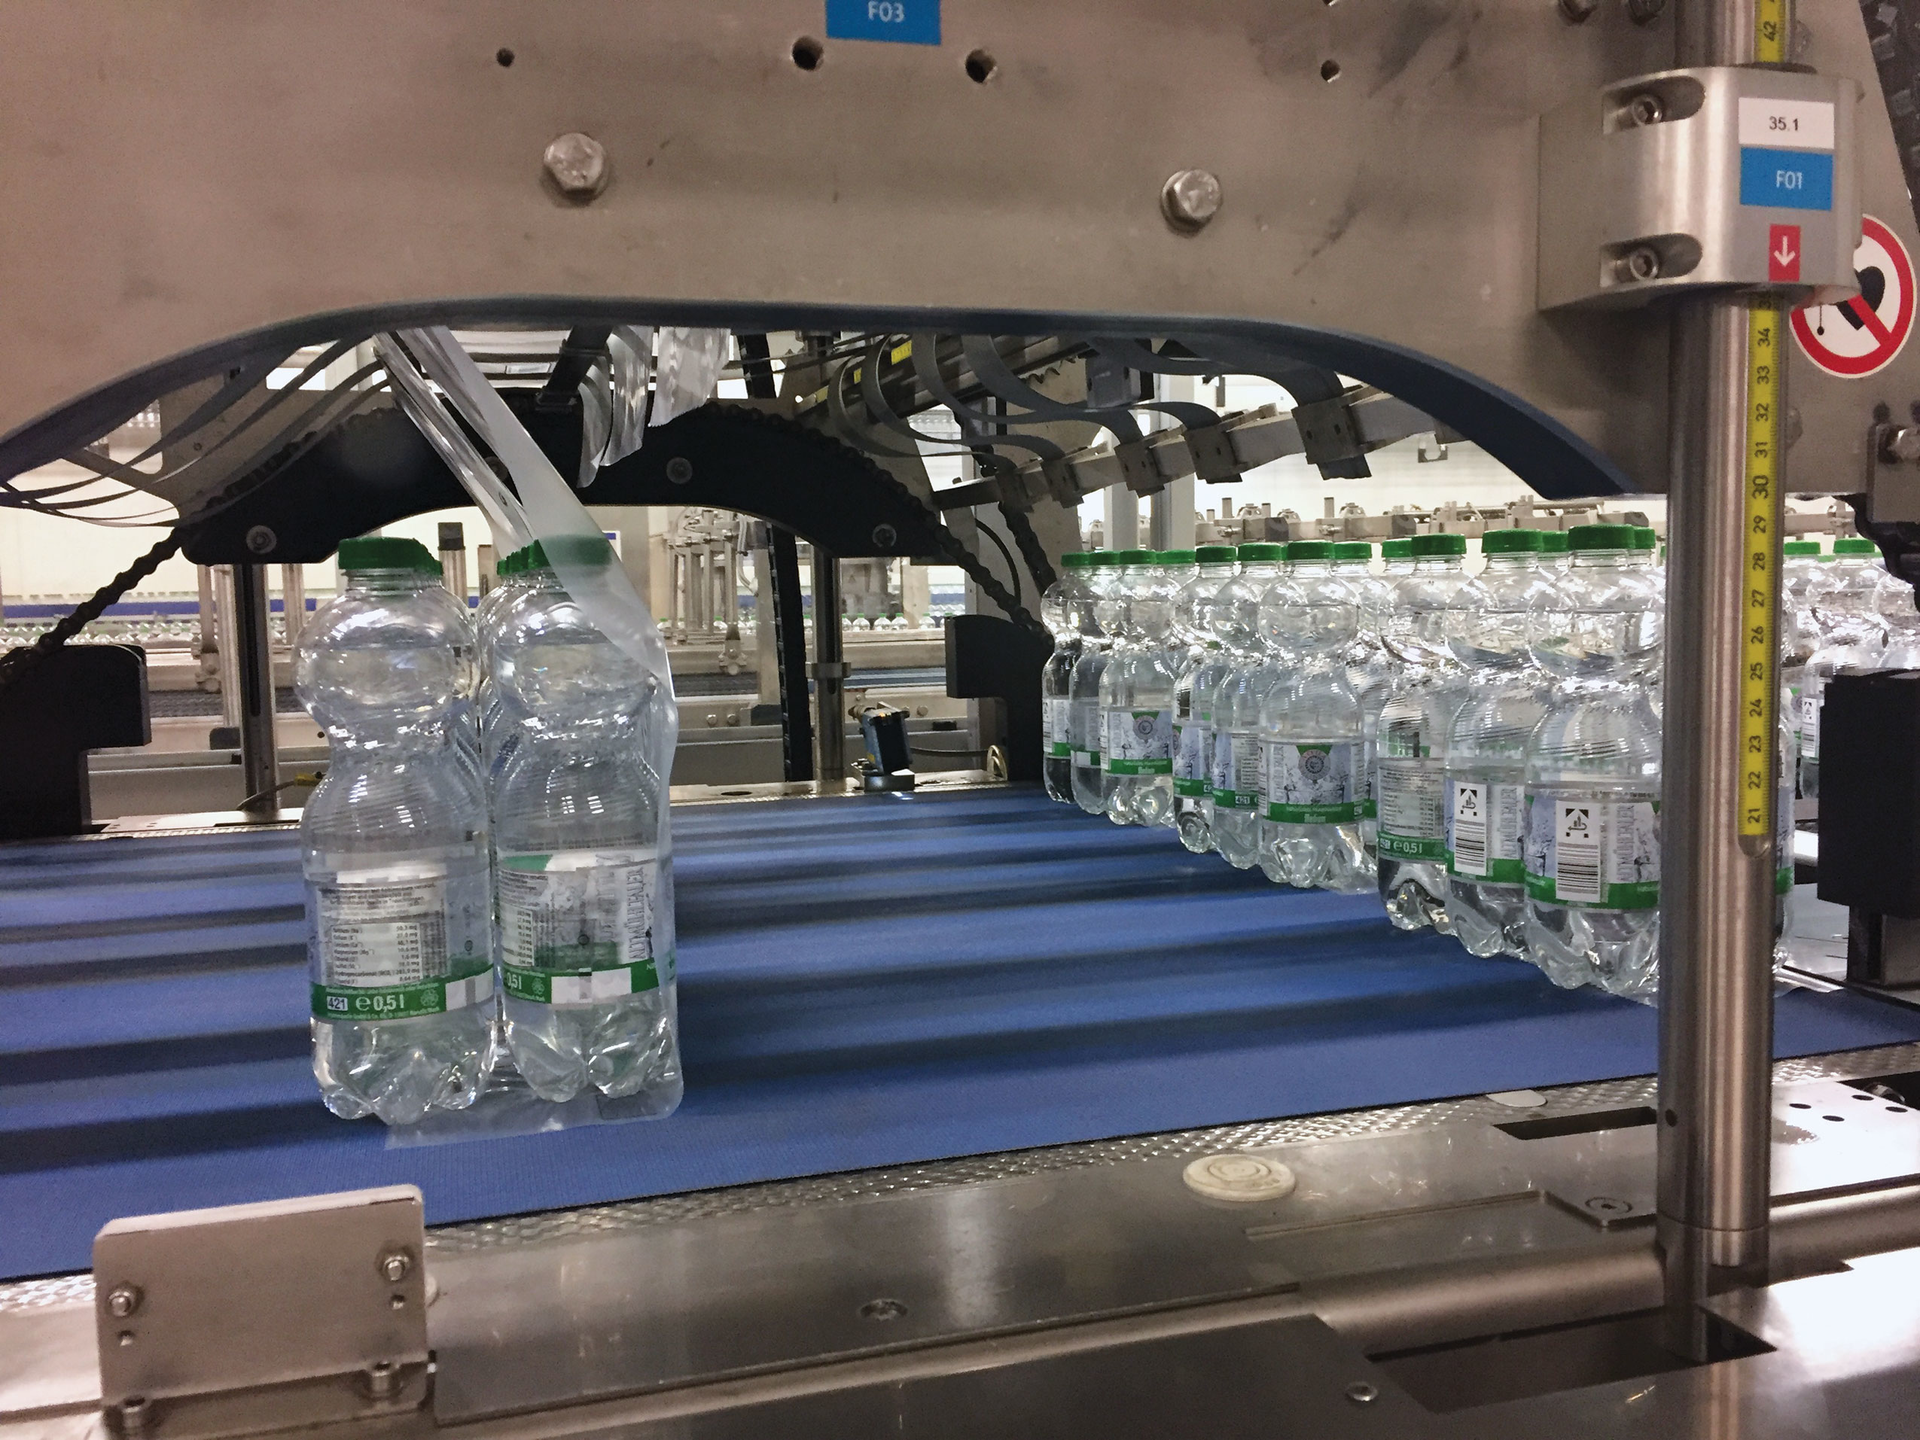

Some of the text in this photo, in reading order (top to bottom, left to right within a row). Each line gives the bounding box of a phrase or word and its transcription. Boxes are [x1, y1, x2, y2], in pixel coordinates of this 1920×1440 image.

[868, 0, 905, 22] F03
[1763, 20, 1777, 42] 42
[1768, 116, 1800, 131] 35.1
[1776, 171, 1803, 189] F01
[1757, 327, 1771, 347] 34
[1757, 365, 1770, 385] 33
[1756, 402, 1769, 422] 32
[1754, 441, 1768, 459] 31
[1752, 475, 1769, 499] 30
[1753, 515, 1767, 534] 29
[1752, 552, 1766, 571] 28
[1751, 589, 1765, 608] 27
[1751, 625, 1764, 644] 26
[1750, 662, 1764, 681] 25
[1749, 698, 1763, 718] 24
[1749, 735, 1762, 753] 23
[1748, 771, 1762, 789] 22
[1748, 807, 1761, 824] 21
[328, 997, 347, 1010] 421
